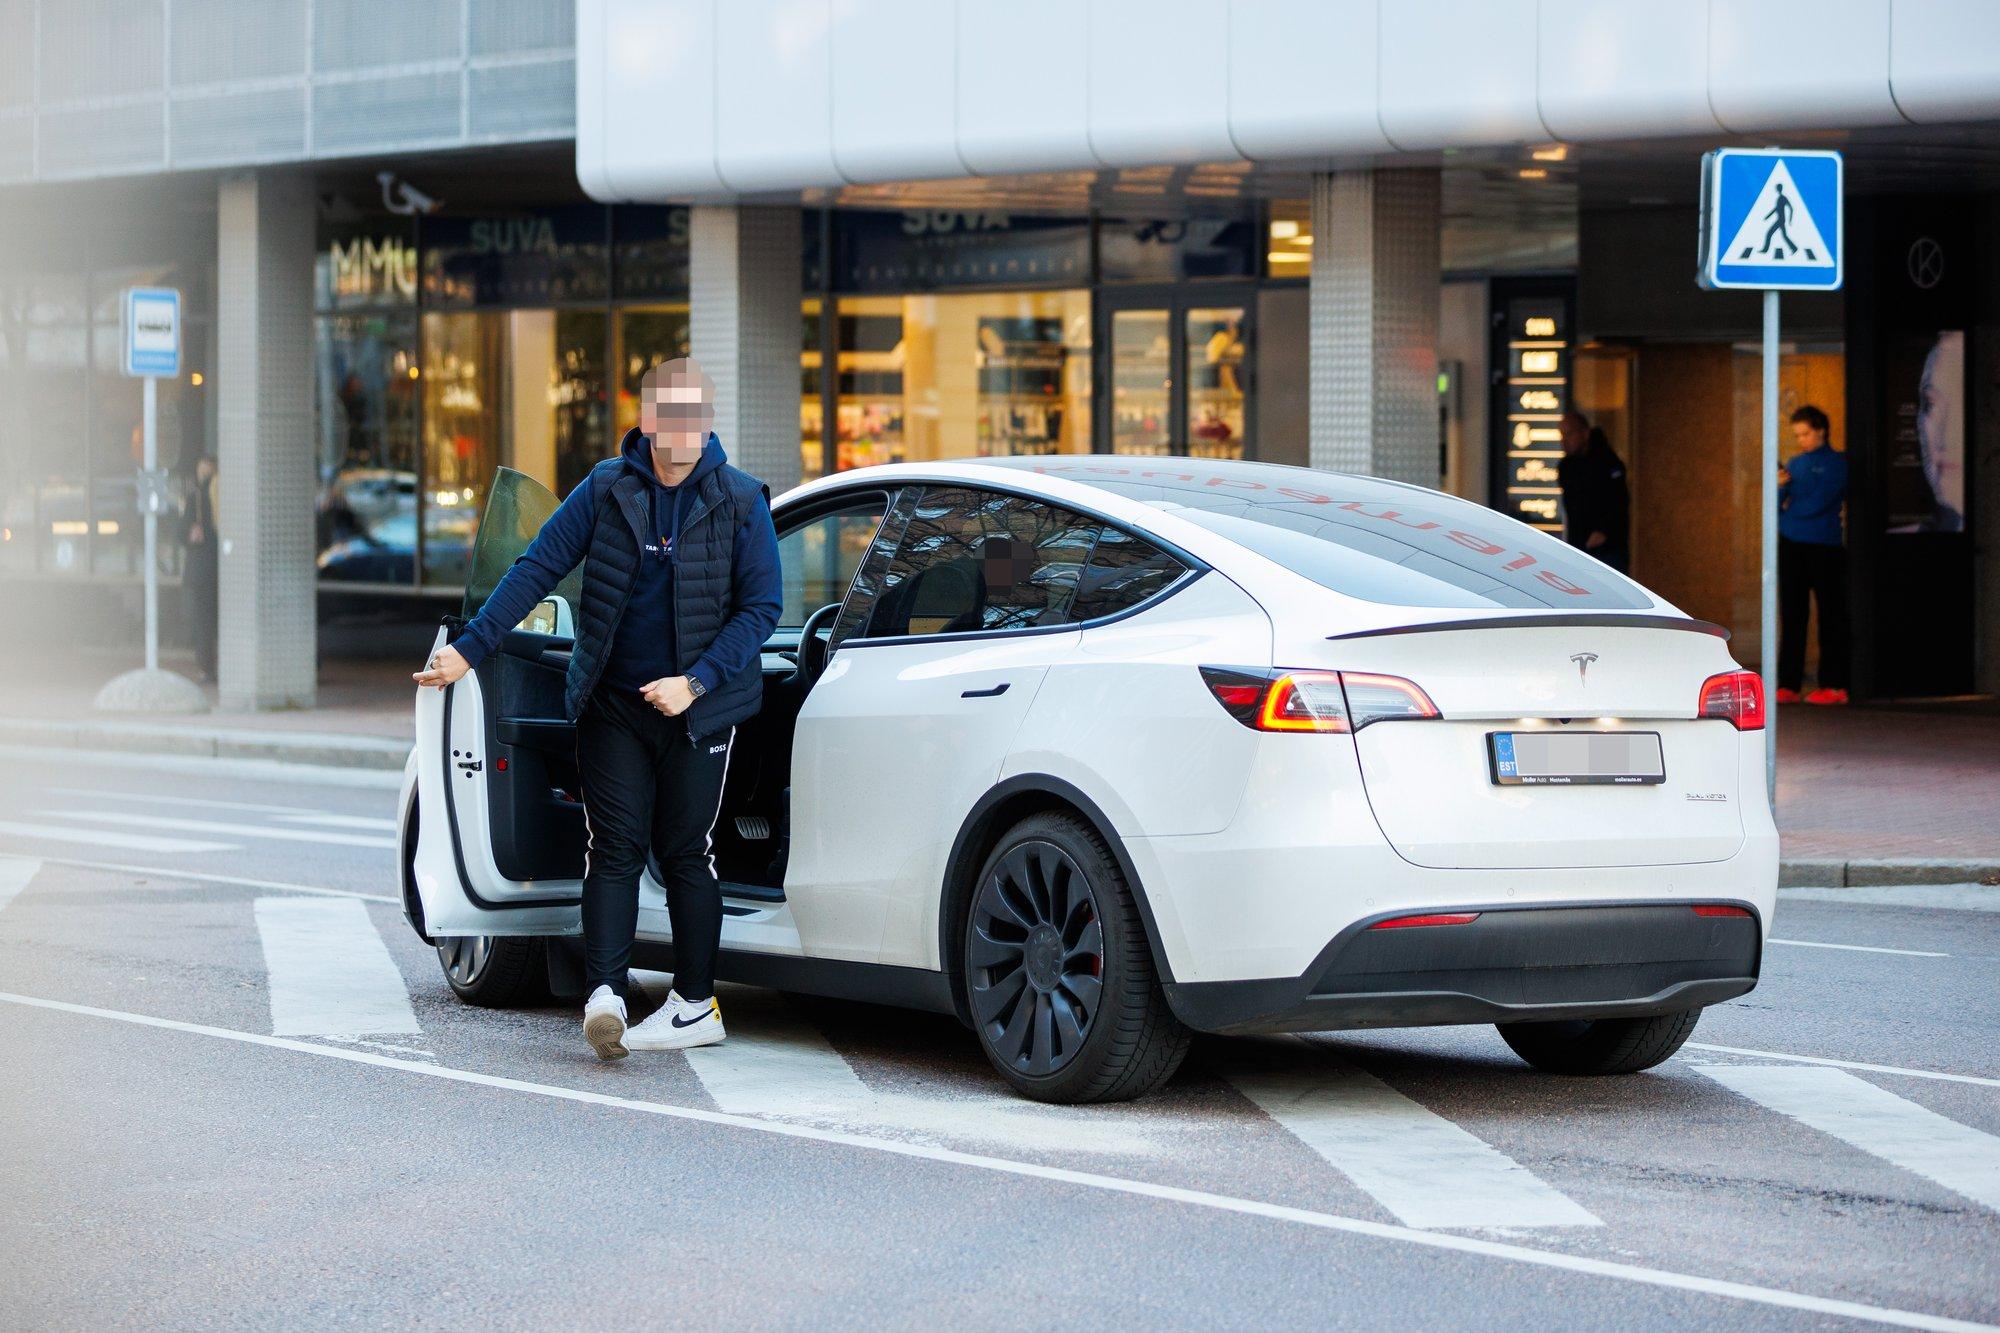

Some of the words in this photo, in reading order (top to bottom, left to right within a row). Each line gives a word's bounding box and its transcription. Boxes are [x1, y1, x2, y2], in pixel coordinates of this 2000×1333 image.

[470, 217, 559, 253] SUVA
[710, 743, 727, 754] BOSS
[1499, 761, 1516, 772] EST
